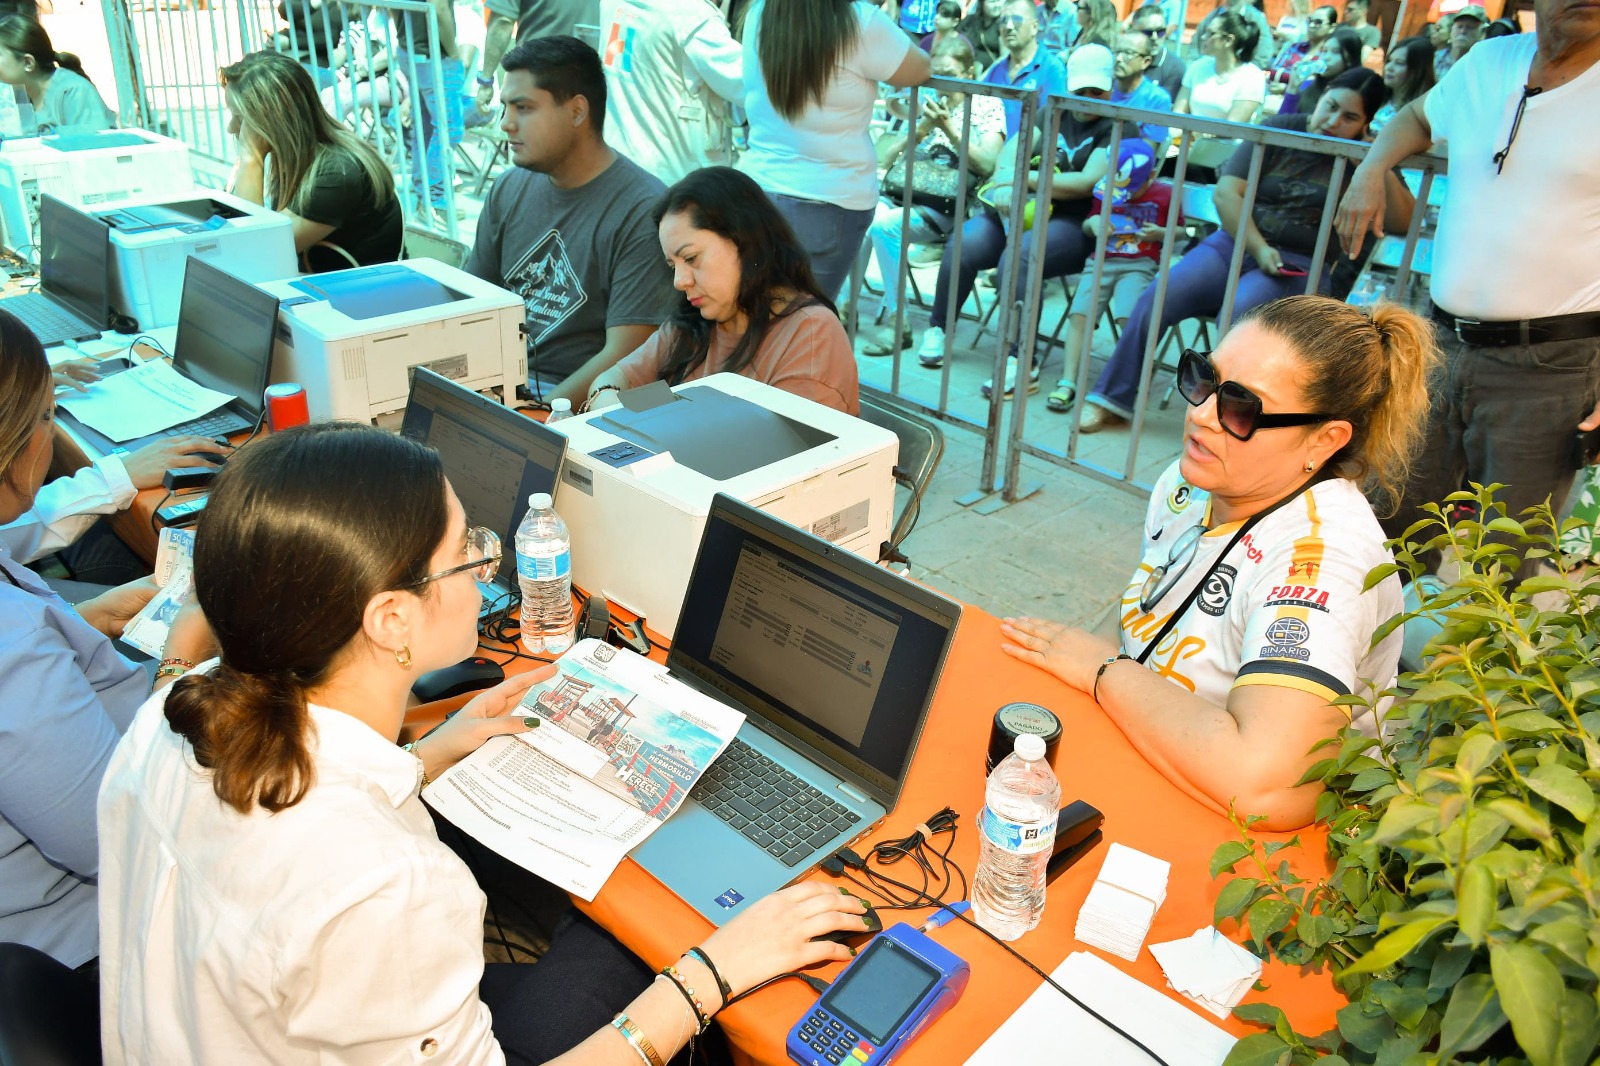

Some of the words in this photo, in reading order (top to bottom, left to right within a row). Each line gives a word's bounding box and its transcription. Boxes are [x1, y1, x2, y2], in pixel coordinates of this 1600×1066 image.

[1266, 585, 1330, 607] FORZA
[1261, 646, 1309, 657] BINARIO
[1014, 721, 1043, 731] PAGADO
[648, 754, 692, 781] HERMOSILLO
[629, 775, 658, 794] CRECE
